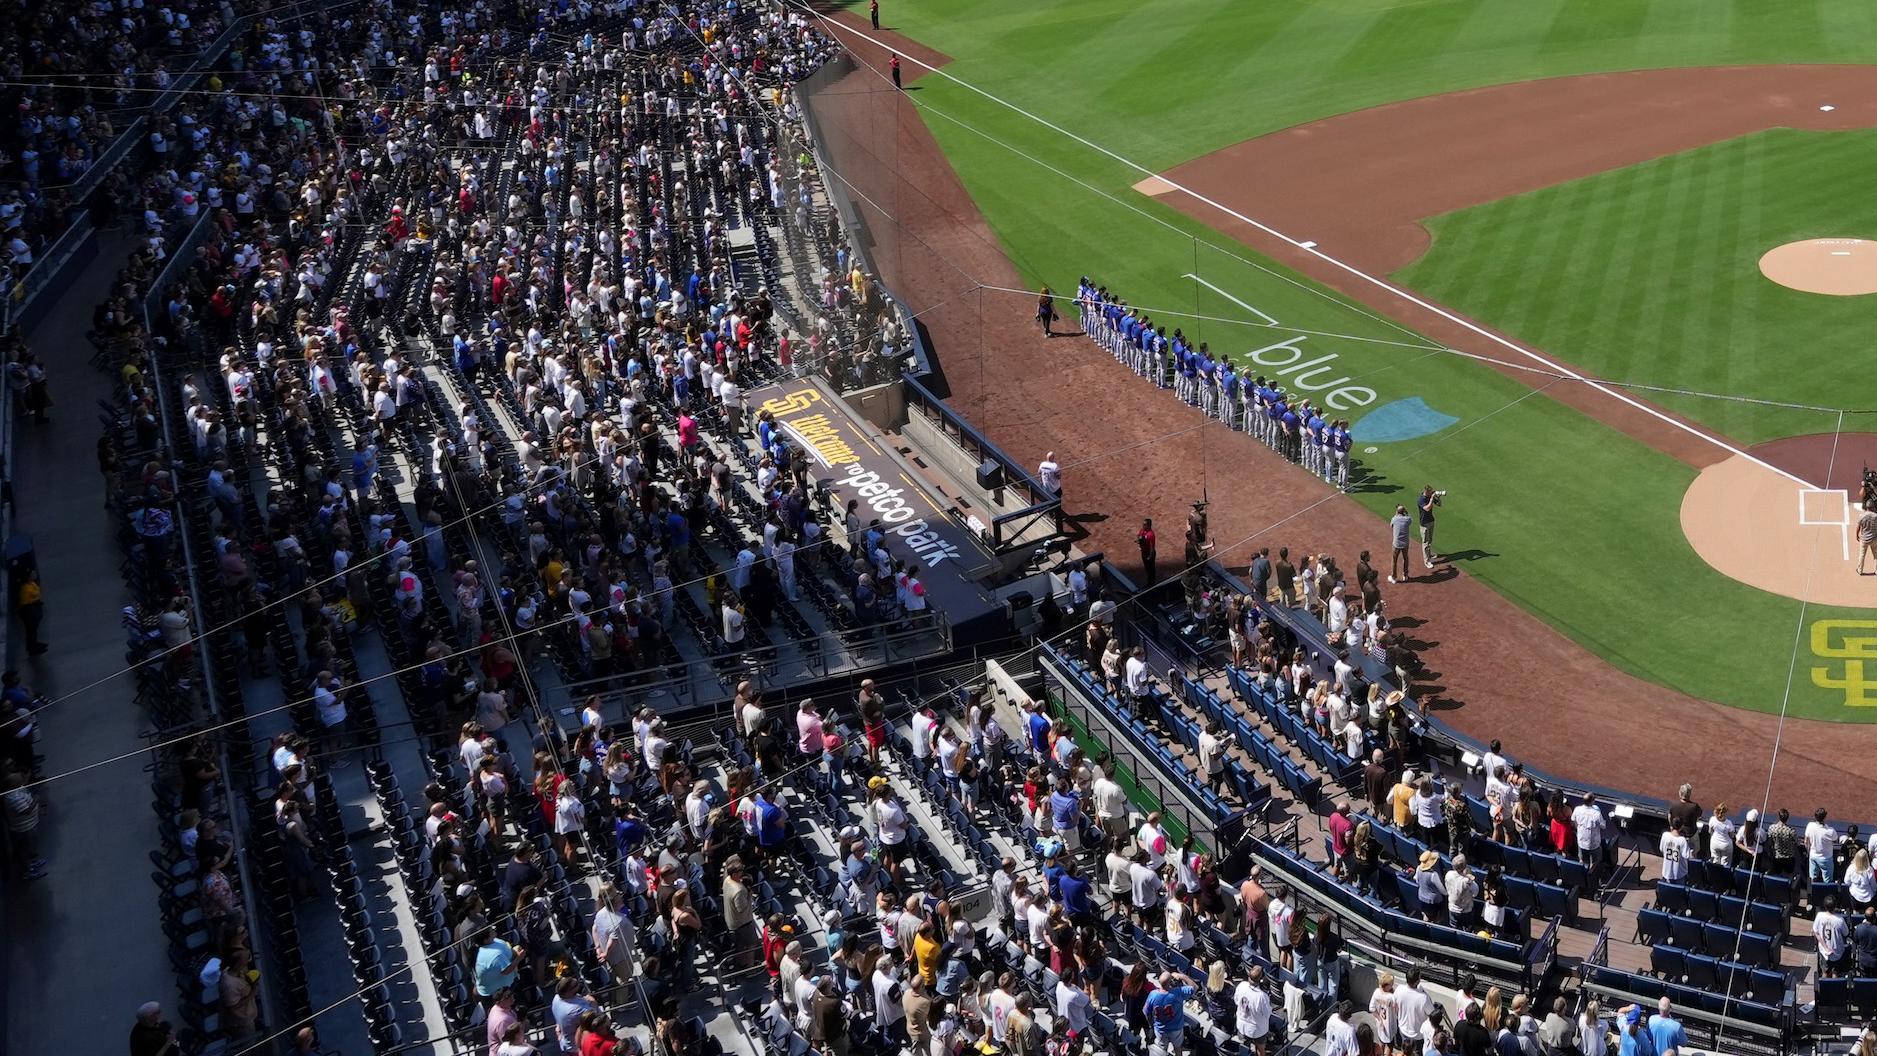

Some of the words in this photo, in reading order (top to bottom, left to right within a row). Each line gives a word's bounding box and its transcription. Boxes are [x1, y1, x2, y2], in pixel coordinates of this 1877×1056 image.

[1244, 335, 1377, 411] blue
[835, 469, 915, 523] petco
[884, 517, 961, 568] park
[1666, 848, 1679, 863] 23
